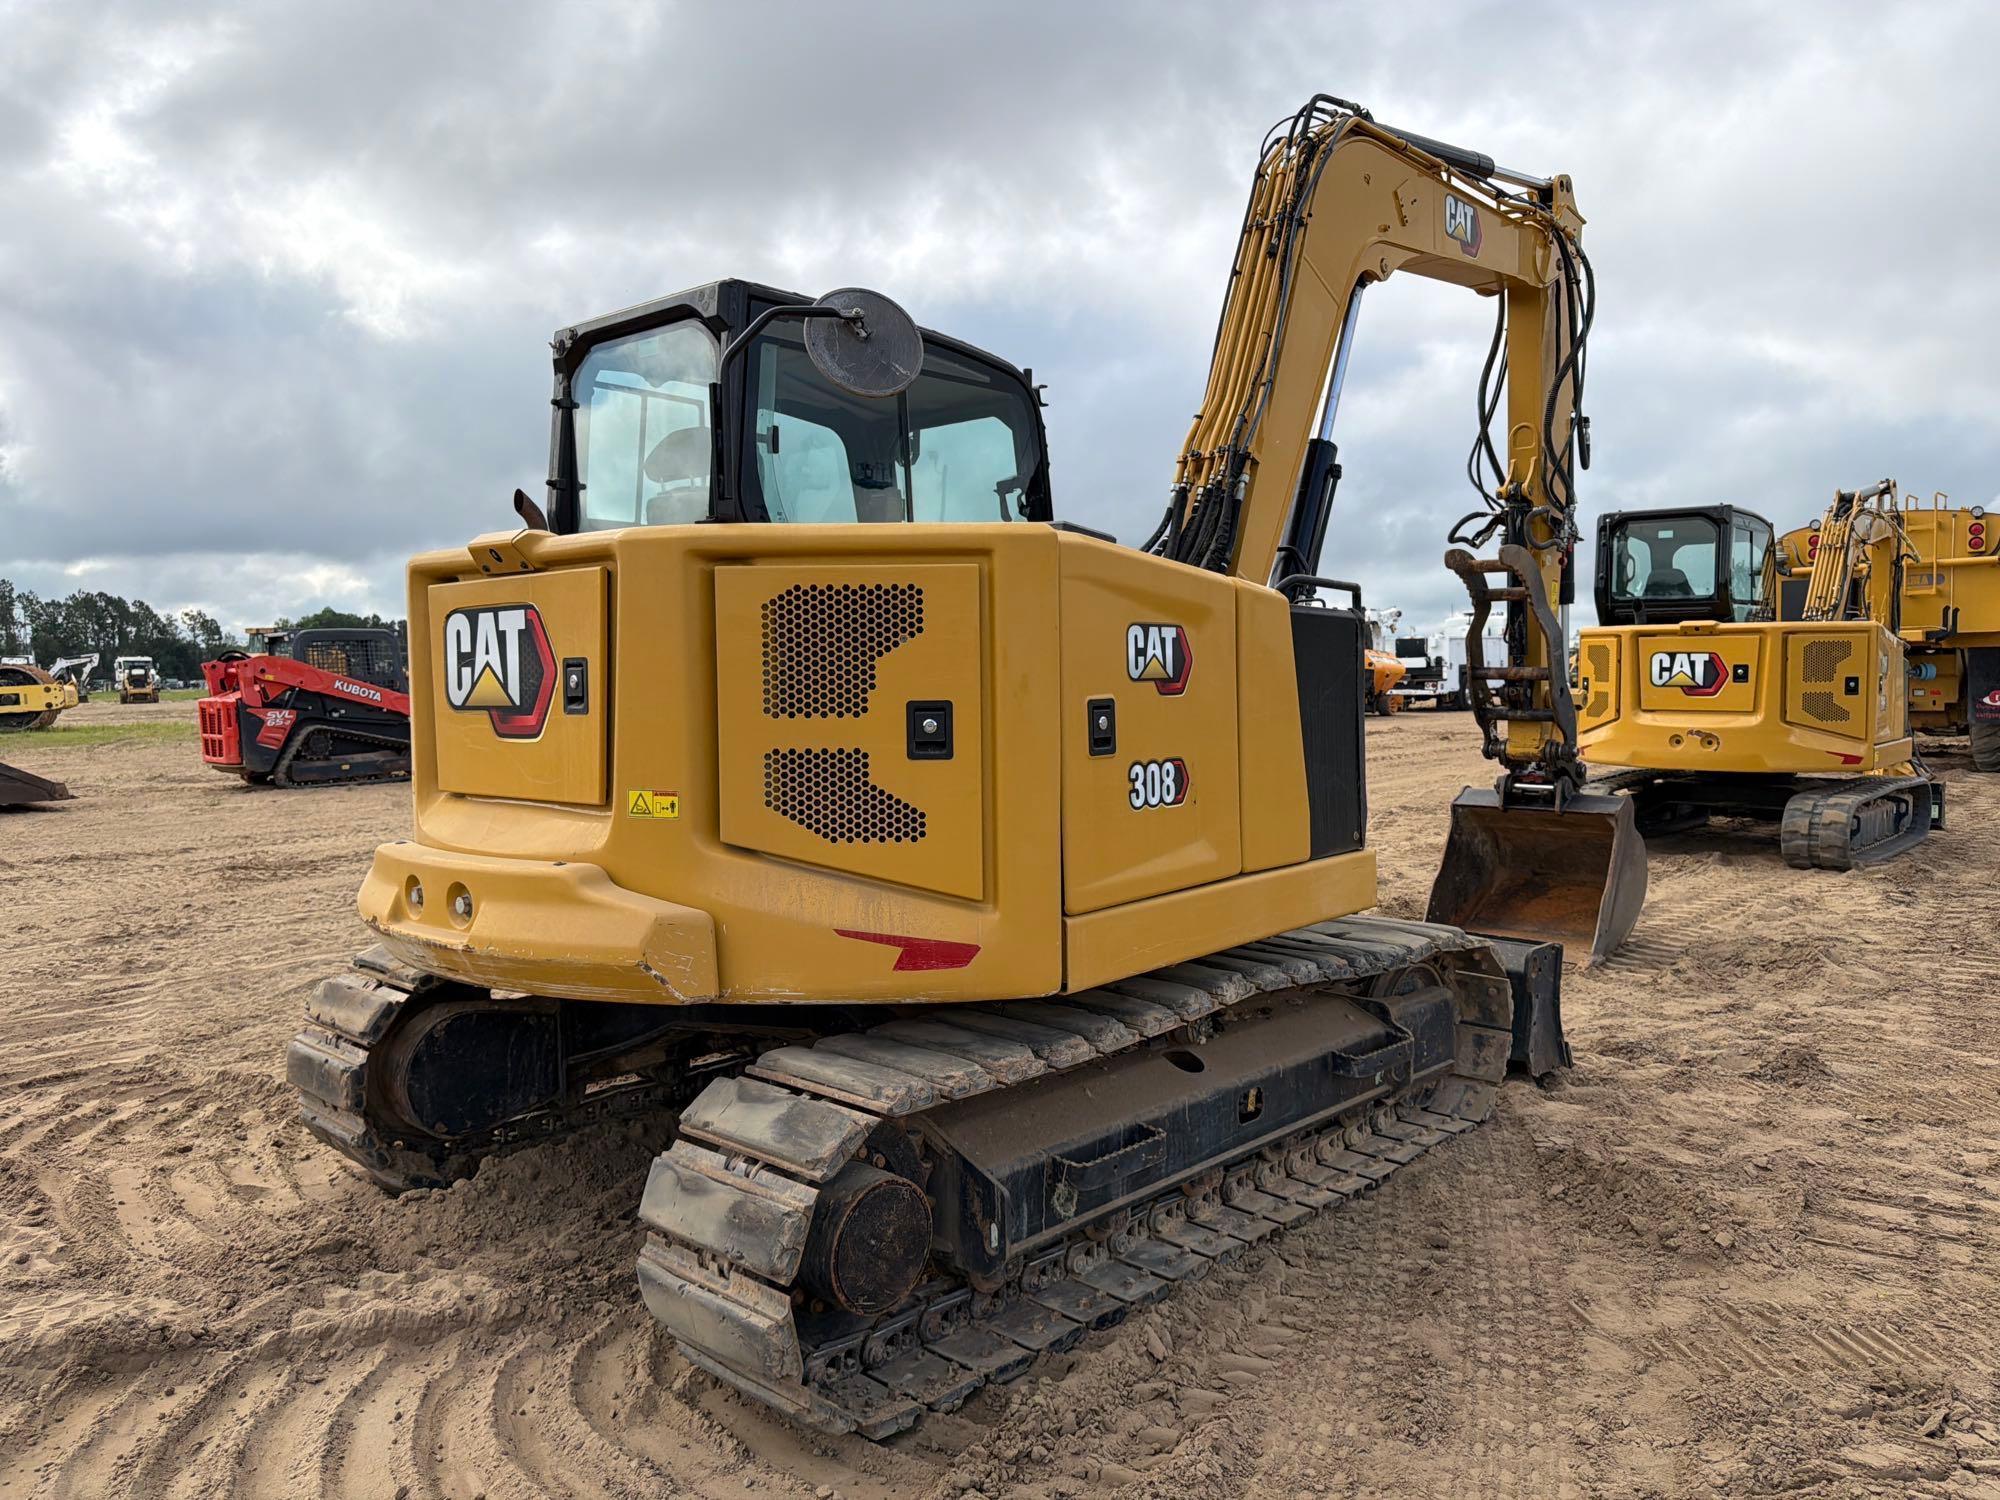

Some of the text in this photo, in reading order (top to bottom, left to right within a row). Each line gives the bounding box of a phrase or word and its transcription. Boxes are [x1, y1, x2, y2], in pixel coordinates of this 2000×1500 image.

[1445, 195, 1474, 244] CAT
[446, 609, 526, 707] CAT
[1127, 625, 1177, 679] CAT
[1651, 652, 1710, 687] CAT
[334, 680, 382, 701] KUBOTA
[266, 710, 293, 719] SVL
[1130, 761, 1176, 807] 308
